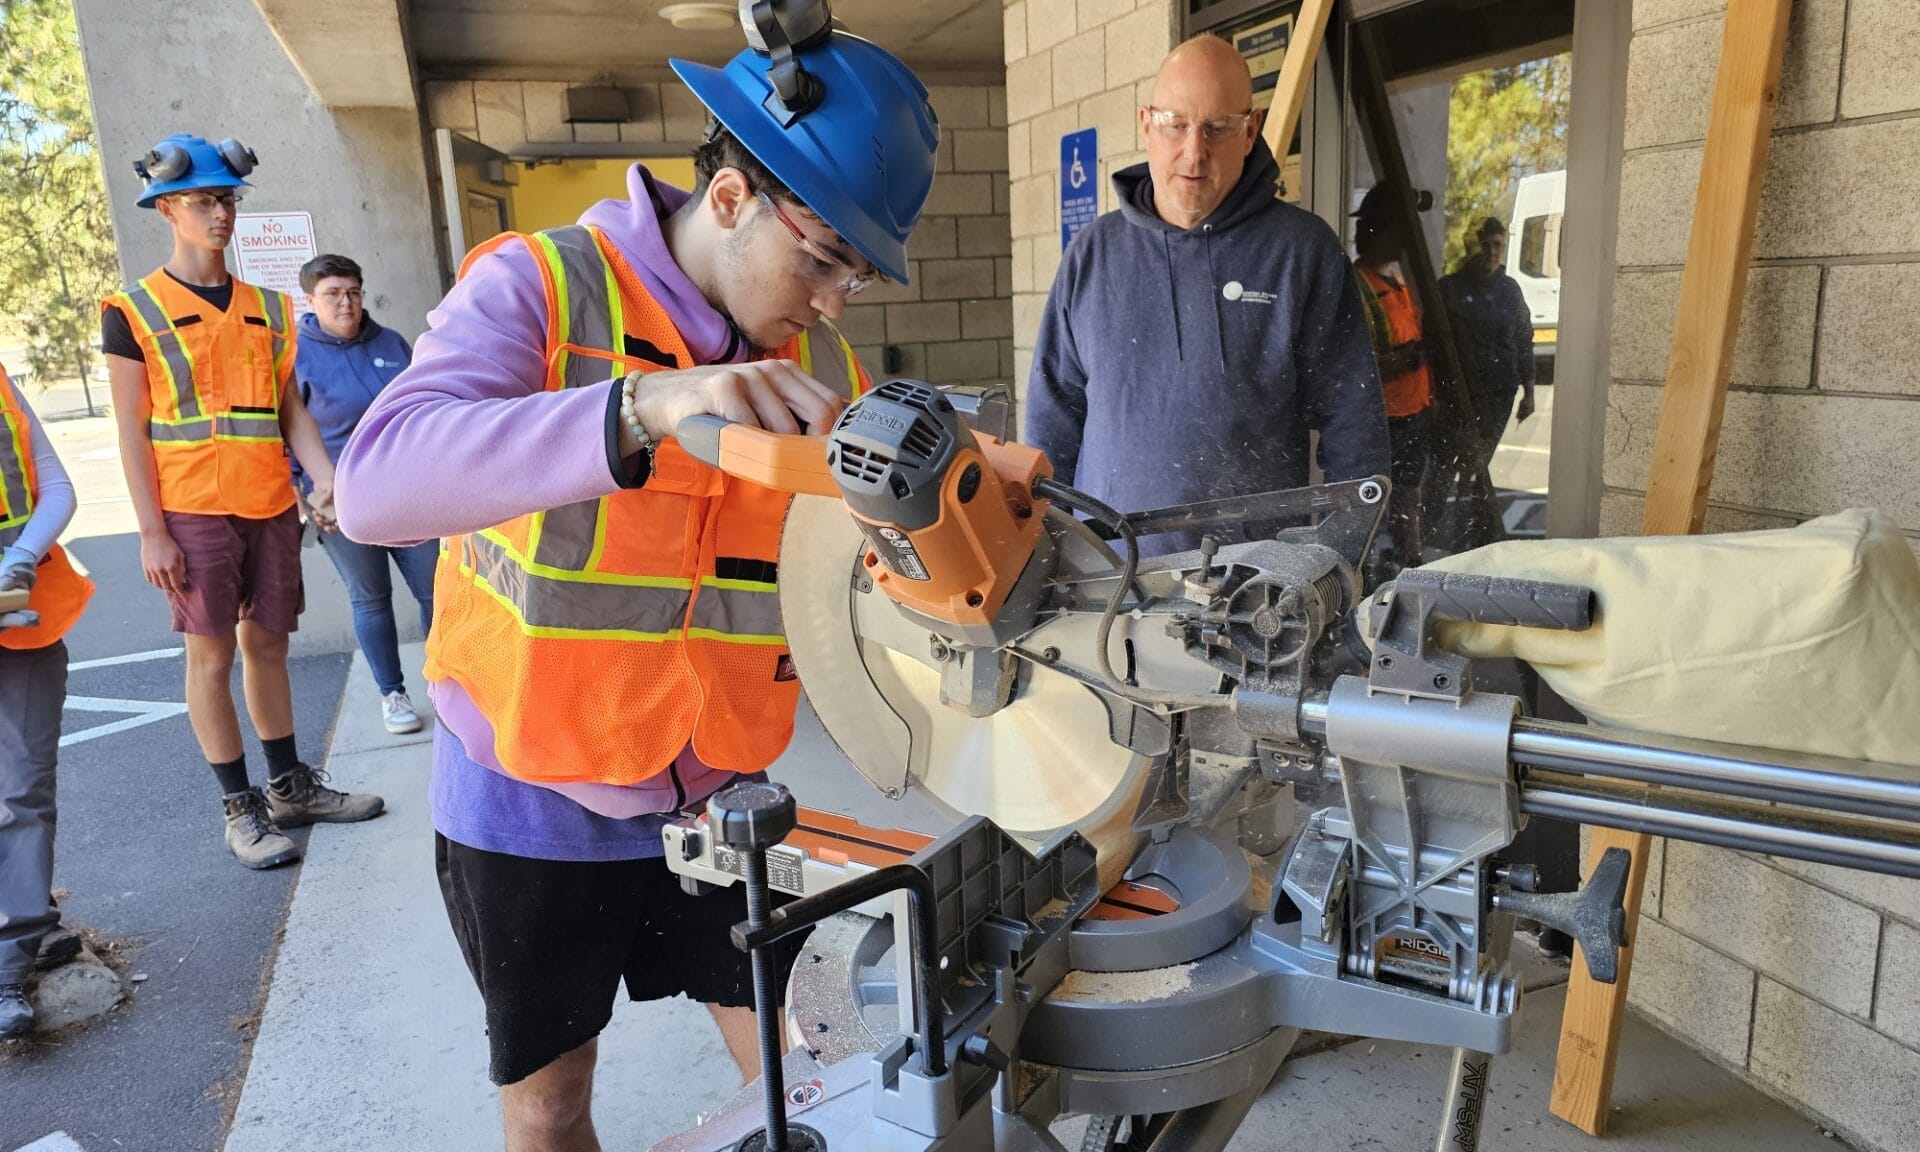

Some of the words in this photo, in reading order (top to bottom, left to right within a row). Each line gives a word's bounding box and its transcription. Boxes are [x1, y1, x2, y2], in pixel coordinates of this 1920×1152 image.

[262, 223, 283, 233] NO
[242, 235, 308, 247] SMOKING
[857, 409, 906, 430] RIDGID
